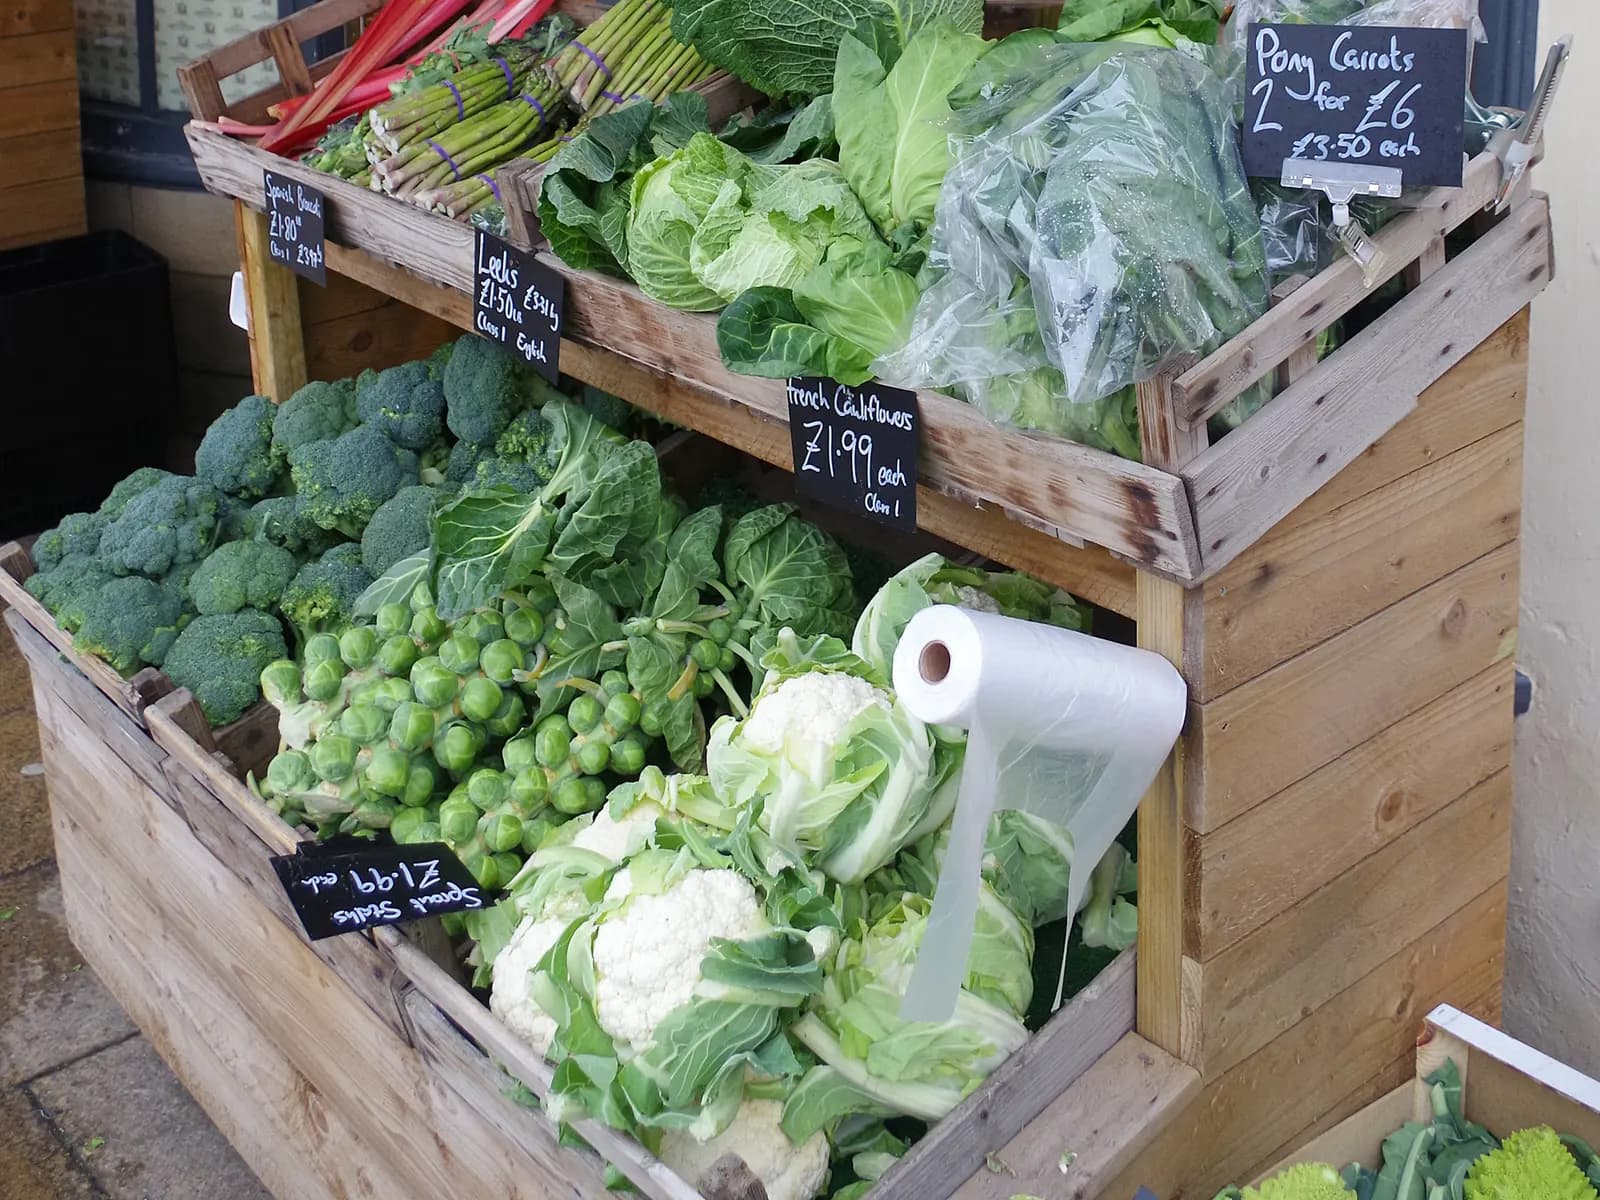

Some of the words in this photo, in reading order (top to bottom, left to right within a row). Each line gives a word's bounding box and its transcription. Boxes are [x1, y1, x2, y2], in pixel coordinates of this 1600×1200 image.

[1255, 27, 1316, 101] Pony
[1328, 31, 1416, 73] Carrots
[1251, 78, 1284, 133] 2
[1313, 80, 1351, 111] for
[1354, 79, 1423, 134] £6
[1291, 132, 1372, 160] £3.50
[1379, 132, 1422, 158] each
[266, 174, 295, 209] Spanish
[478, 232, 519, 289] Leeks
[477, 310, 499, 338] Class
[516, 331, 547, 363] English
[787, 376, 830, 410] French
[834, 384, 913, 431] Cauliflowers
[802, 421, 872, 488] £1.99
[878, 459, 907, 486] each
[301, 872, 338, 894] each
[350, 859, 441, 893] £1.99
[409, 882, 482, 913] Sprout
[333, 900, 401, 924] Stalks
